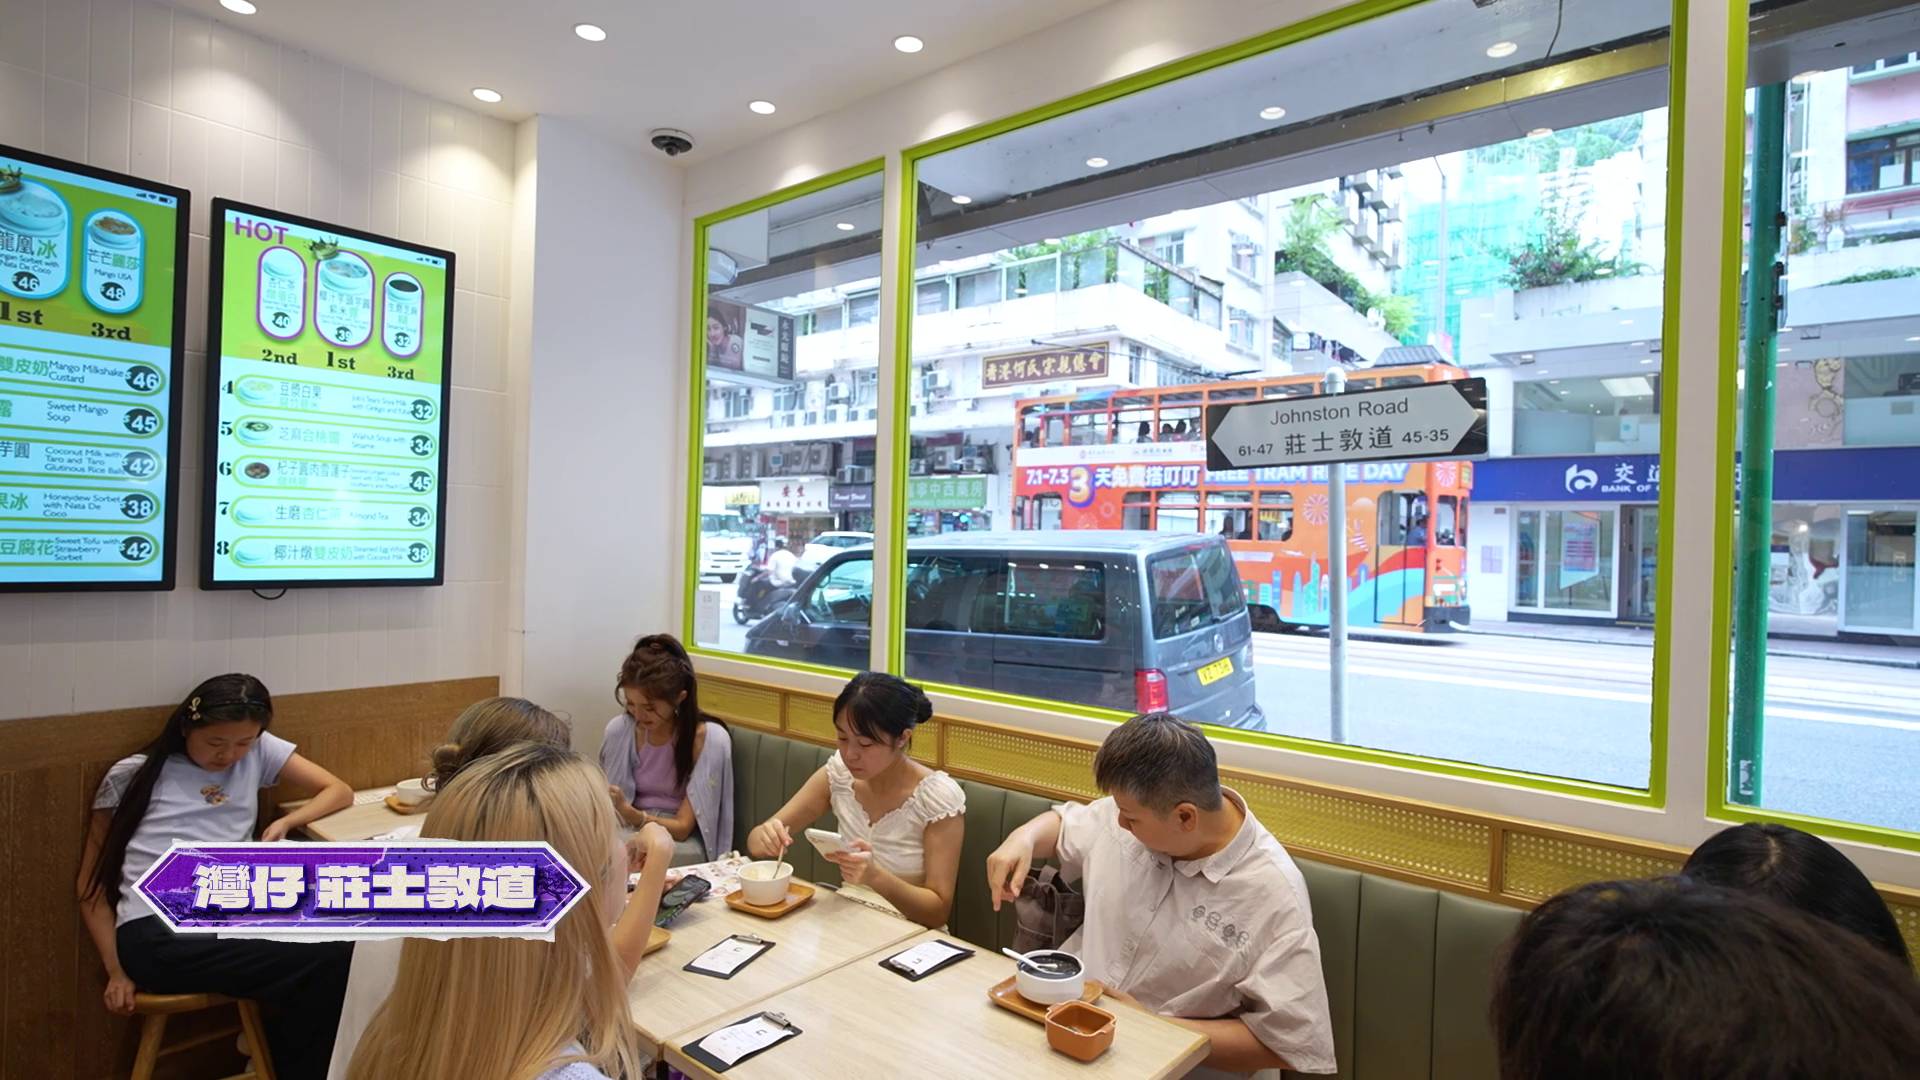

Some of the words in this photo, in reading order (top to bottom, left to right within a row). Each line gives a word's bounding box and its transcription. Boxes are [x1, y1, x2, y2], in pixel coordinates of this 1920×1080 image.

[235, 217, 289, 245] HOT
[91, 322, 132, 341] 3rd
[262, 349, 298, 366] 2nd
[326, 350, 356, 371] 1st
[49, 360, 80, 374] Mango
[387, 366, 415, 381] 3rd
[49, 371, 85, 384] Custard
[222, 381, 233, 395] 4
[47, 400, 76, 412] Sweet
[78, 403, 109, 416] Mango
[1270, 403, 1350, 425] Johnston
[1358, 398, 1409, 417] Road
[47, 411, 71, 424] Soup
[221, 421, 233, 436] 5
[1284, 425, 1394, 455] 莊士敦道
[1402, 429, 1450, 444] 45-35
[45, 446, 82, 456] Coconut
[85, 449, 102, 457] Milk
[1238, 443, 1273, 457] 61-47
[45, 455, 65, 463] Taro
[67, 457, 83, 465] and
[87, 457, 105, 466] Taro
[44, 463, 85, 473] Glutinous
[87, 466, 106, 474] Rice
[219, 461, 232, 476] 6
[1203, 466, 1250, 482] FREE
[1254, 464, 1307, 482] TRAM
[1312, 464, 1359, 481] RIE
[1363, 463, 1410, 481] DAY
[1601, 484, 1631, 493] BANK
[1636, 484, 1652, 493] OF
[43, 493, 90, 503] Honeydew
[93, 495, 120, 503] Sorbet
[43, 501, 62, 509] with
[64, 502, 86, 510] Nata
[88, 502, 101, 510] De
[219, 502, 229, 516] 7
[42, 509, 67, 518] Coco
[54, 536, 81, 545] Sweet
[83, 537, 101, 545] Tofu
[54, 545, 101, 554] Strawberry
[217, 541, 229, 555] 8
[54, 553, 83, 561] Sorbet
